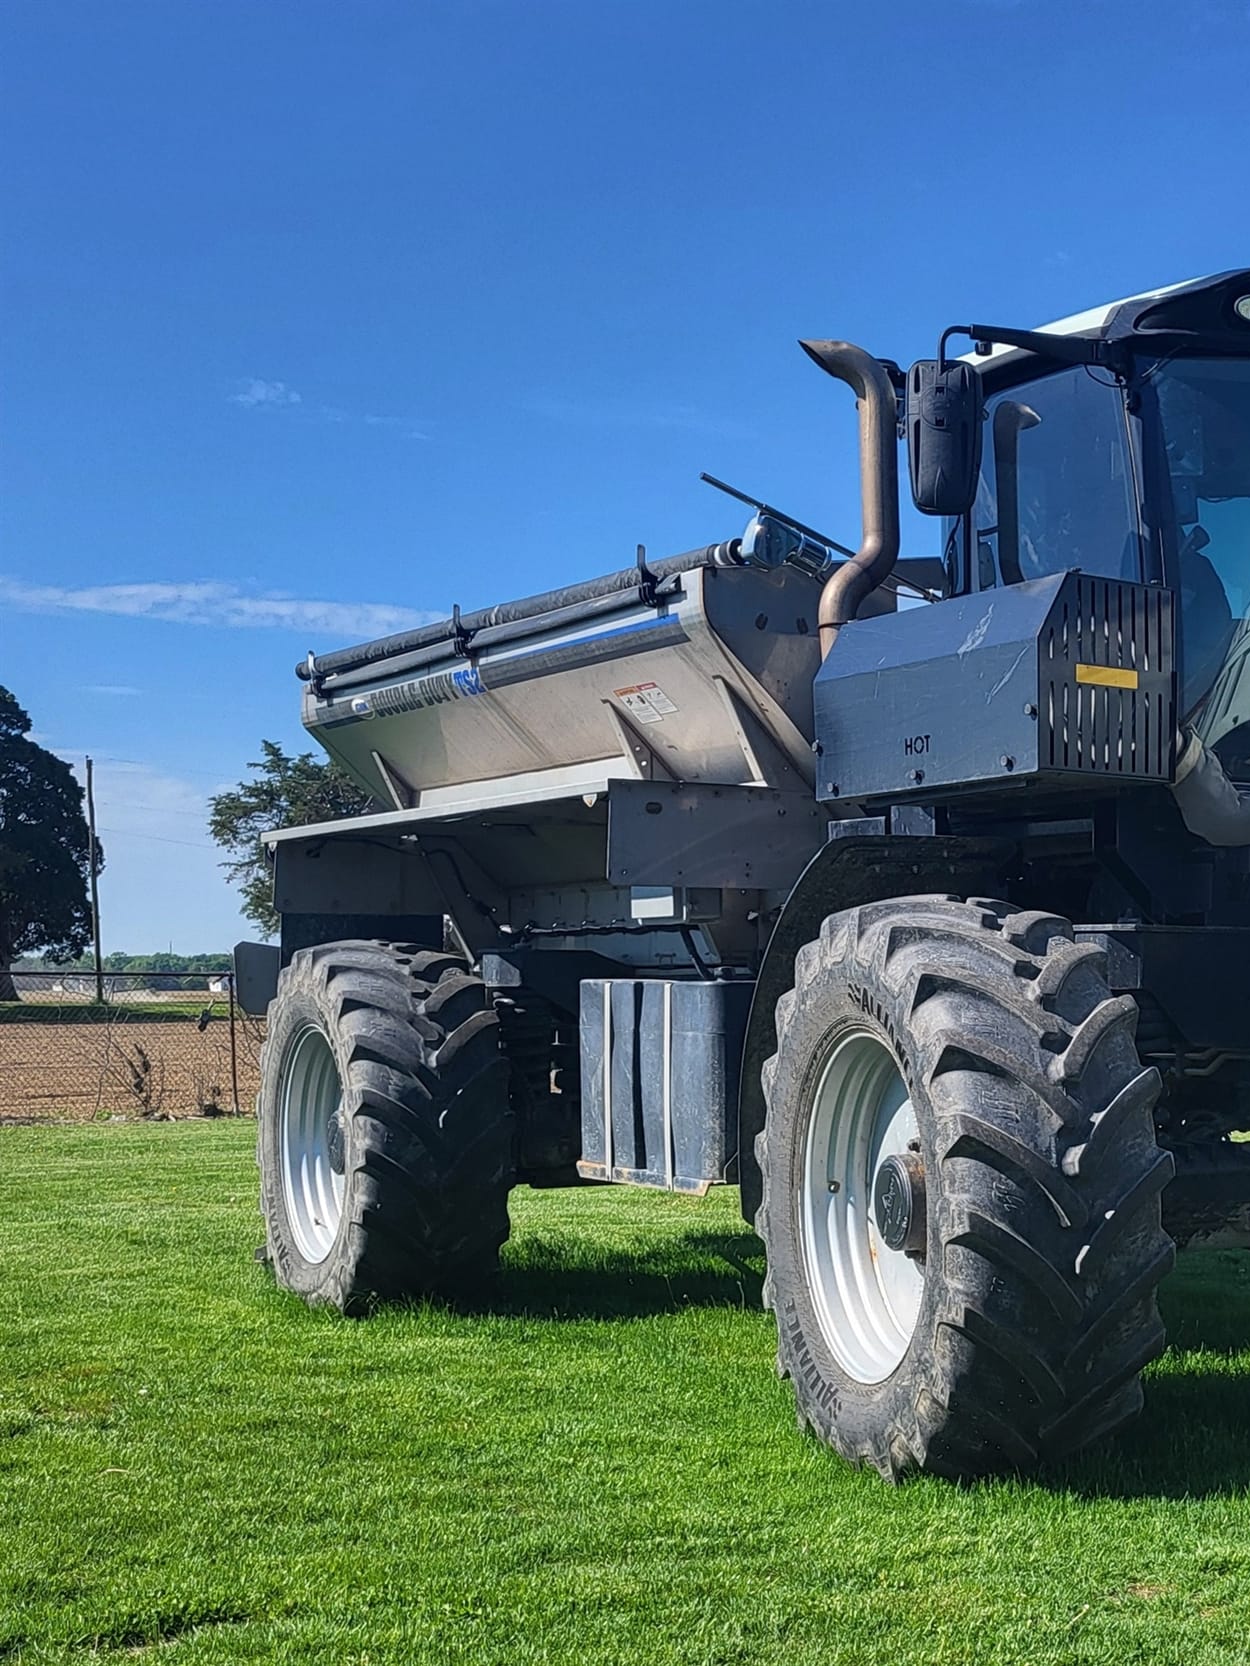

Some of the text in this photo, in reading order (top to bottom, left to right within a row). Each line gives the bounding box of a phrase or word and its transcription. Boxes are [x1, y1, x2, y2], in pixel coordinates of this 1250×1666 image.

[453, 668, 487, 697] TS2
[904, 734, 931, 756] HOT
[783, 1298, 840, 1410] ALLIANCE
